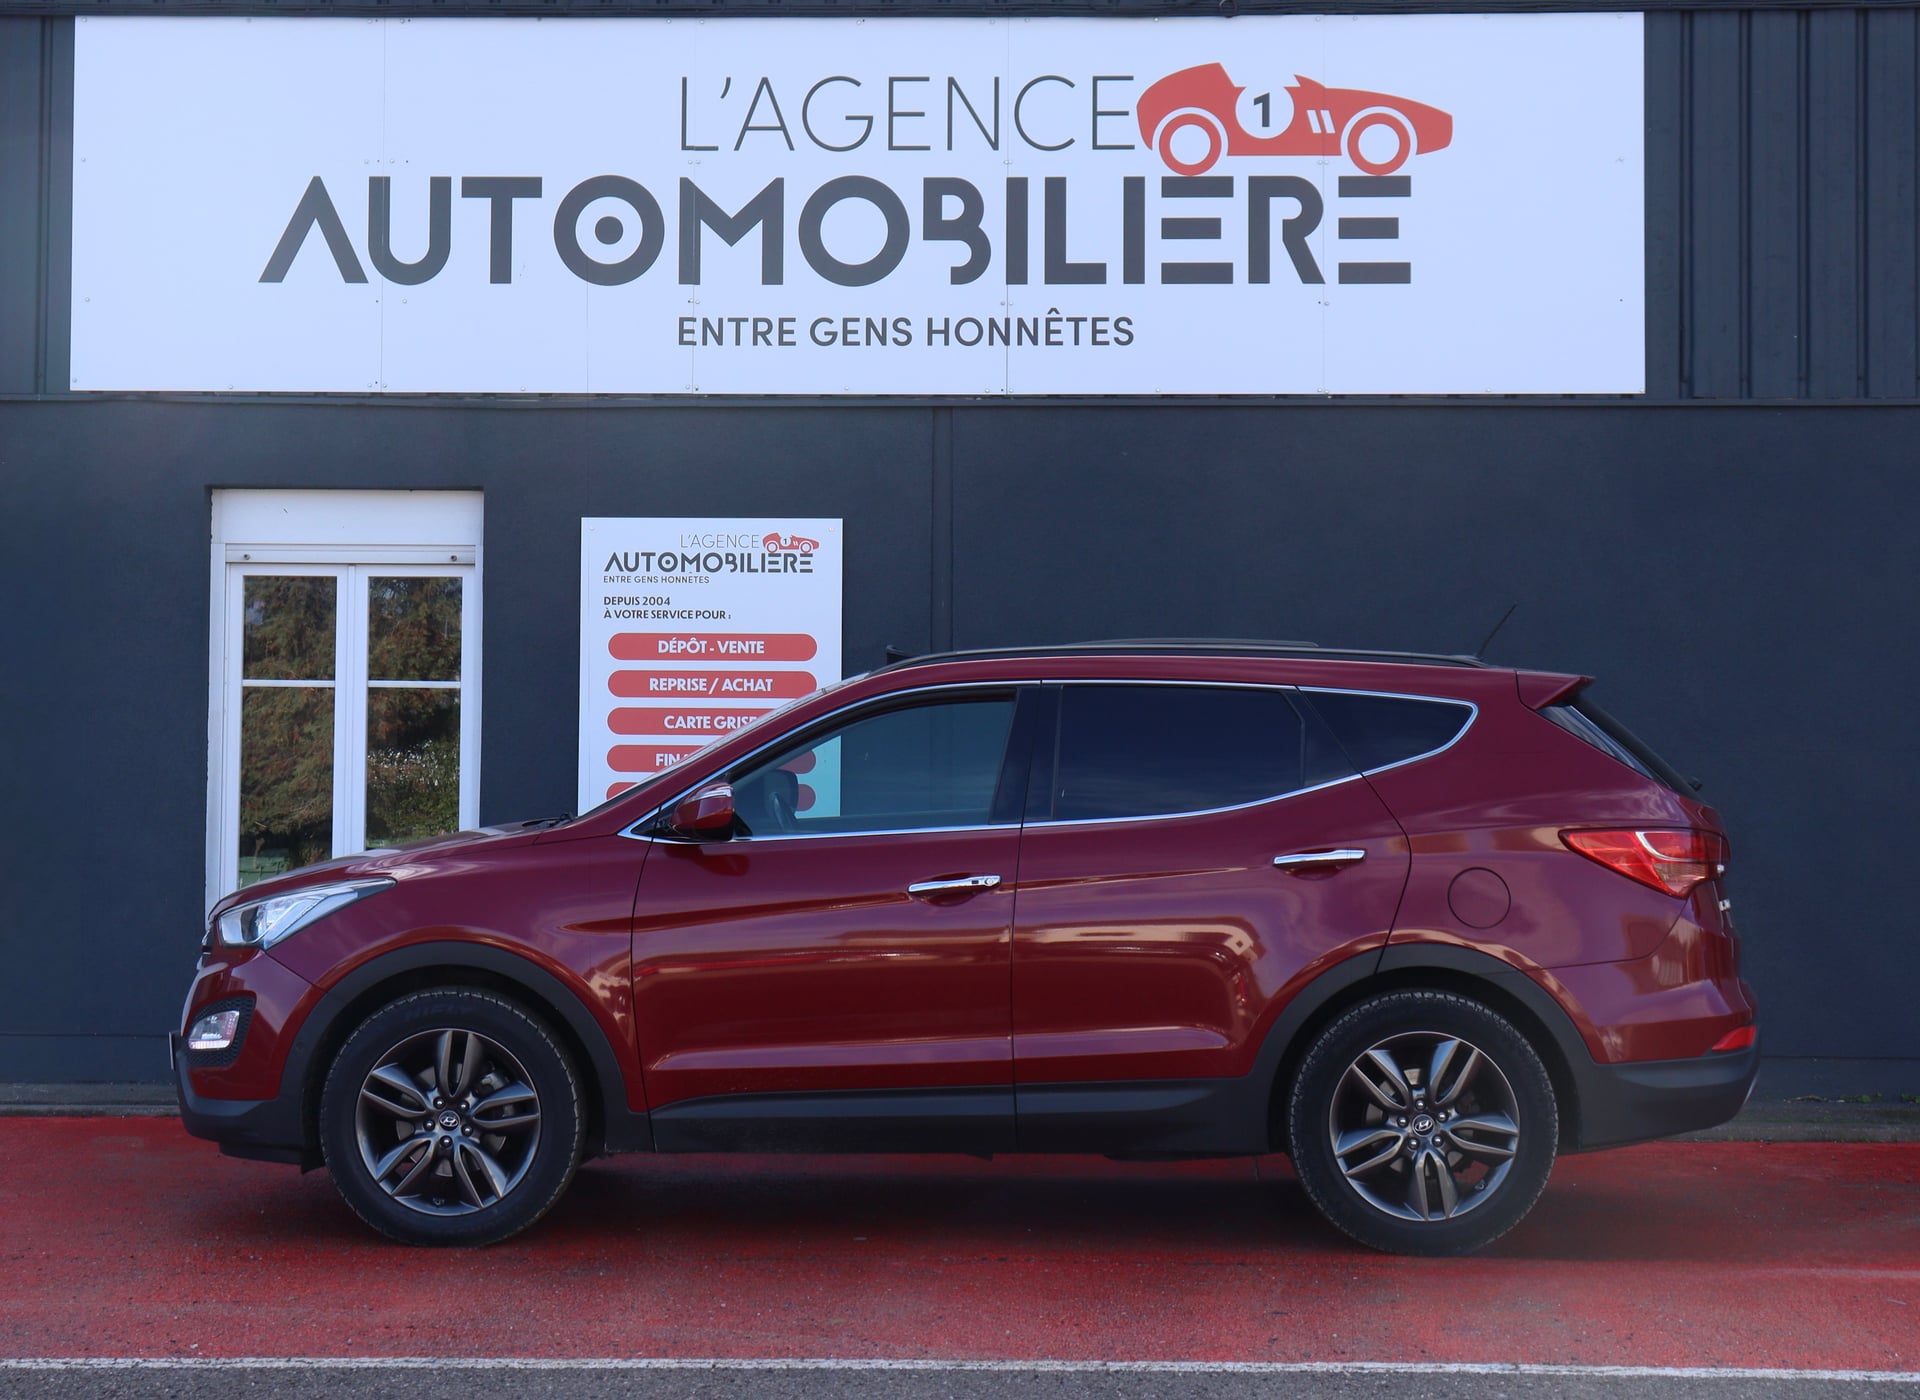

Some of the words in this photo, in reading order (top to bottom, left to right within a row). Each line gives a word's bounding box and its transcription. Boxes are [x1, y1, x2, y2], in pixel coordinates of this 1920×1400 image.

[1252, 91, 1271, 128] 1
[678, 317, 797, 346] ENTRE
[809, 317, 913, 346] GENS
[927, 308, 1135, 347] HONNÊTES
[603, 575, 632, 583] ENTRE
[635, 575, 659, 583] GENS
[661, 572, 710, 584] HONNÊTES
[603, 596, 640, 606] DEPUIS
[642, 596, 671, 606] 2004
[603, 607, 612, 619] À
[614, 609, 649, 619] VOTRE
[650, 609, 694, 619] SERVICE
[695, 610, 726, 620] POUR
[657, 637, 707, 654] DÉPÔT
[717, 640, 765, 654] VENTE
[649, 678, 708, 692] REPRISE
[721, 678, 773, 692] ACHAT
[663, 715, 711, 729] CARTE
